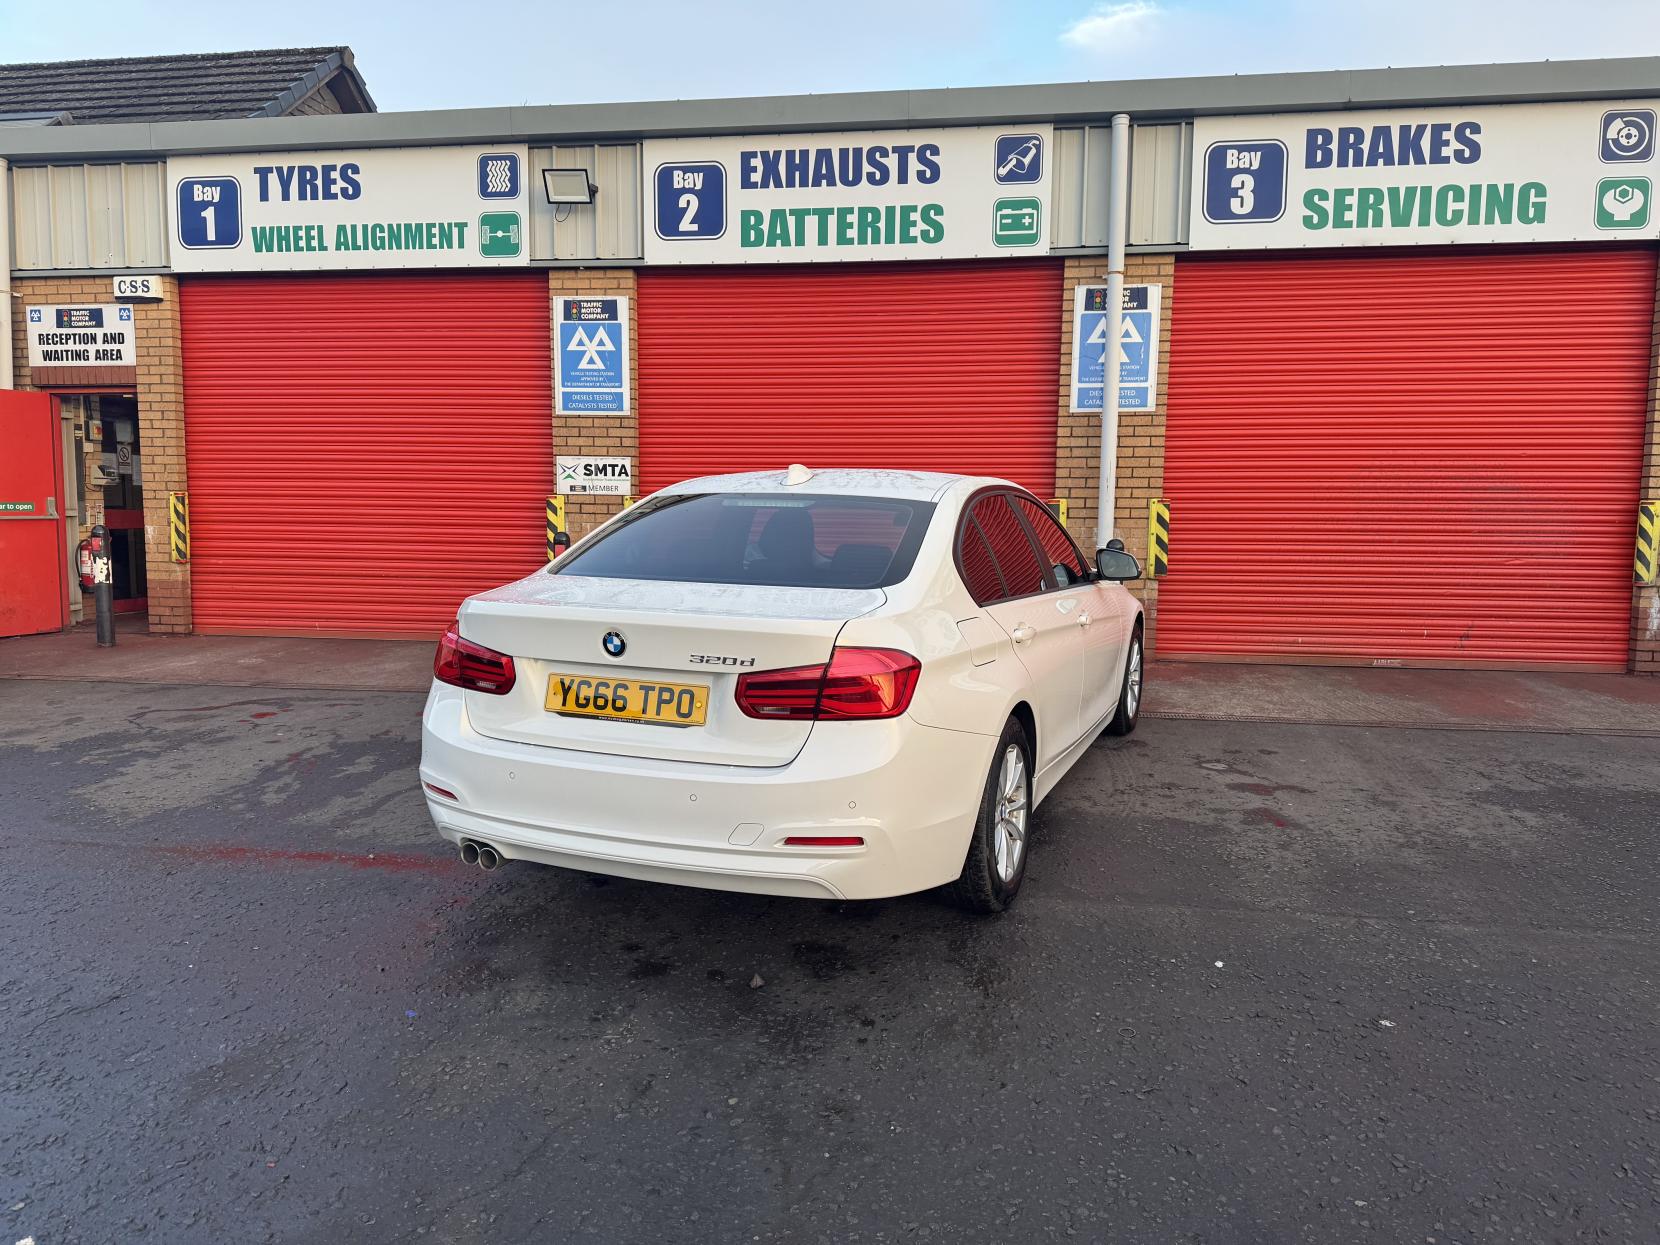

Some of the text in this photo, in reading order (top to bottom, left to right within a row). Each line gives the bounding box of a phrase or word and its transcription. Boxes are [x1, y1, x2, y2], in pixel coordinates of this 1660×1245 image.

[1226, 149, 1261, 170] Bay
[1304, 121, 1482, 169] BRAKES
[253, 162, 362, 202] TYRES
[673, 170, 703, 190] Bay
[740, 143, 941, 189] EXHAUSTS
[193, 184, 221, 203] Bay
[1230, 173, 1255, 215] 3
[1302, 181, 1548, 231] SERVICING
[201, 206, 216, 241] 1
[678, 193, 699, 232] 2
[740, 203, 945, 248] BATTERIES
[251, 221, 468, 253] WHEEL ALIGNMENT
[38, 332, 125, 346] RECEPTION AND
[42, 348, 123, 362] WAITING AREA
[583, 463, 629, 477] SMTA
[689, 654, 756, 667] 320d
[559, 677, 695, 719] YG66 TPO
